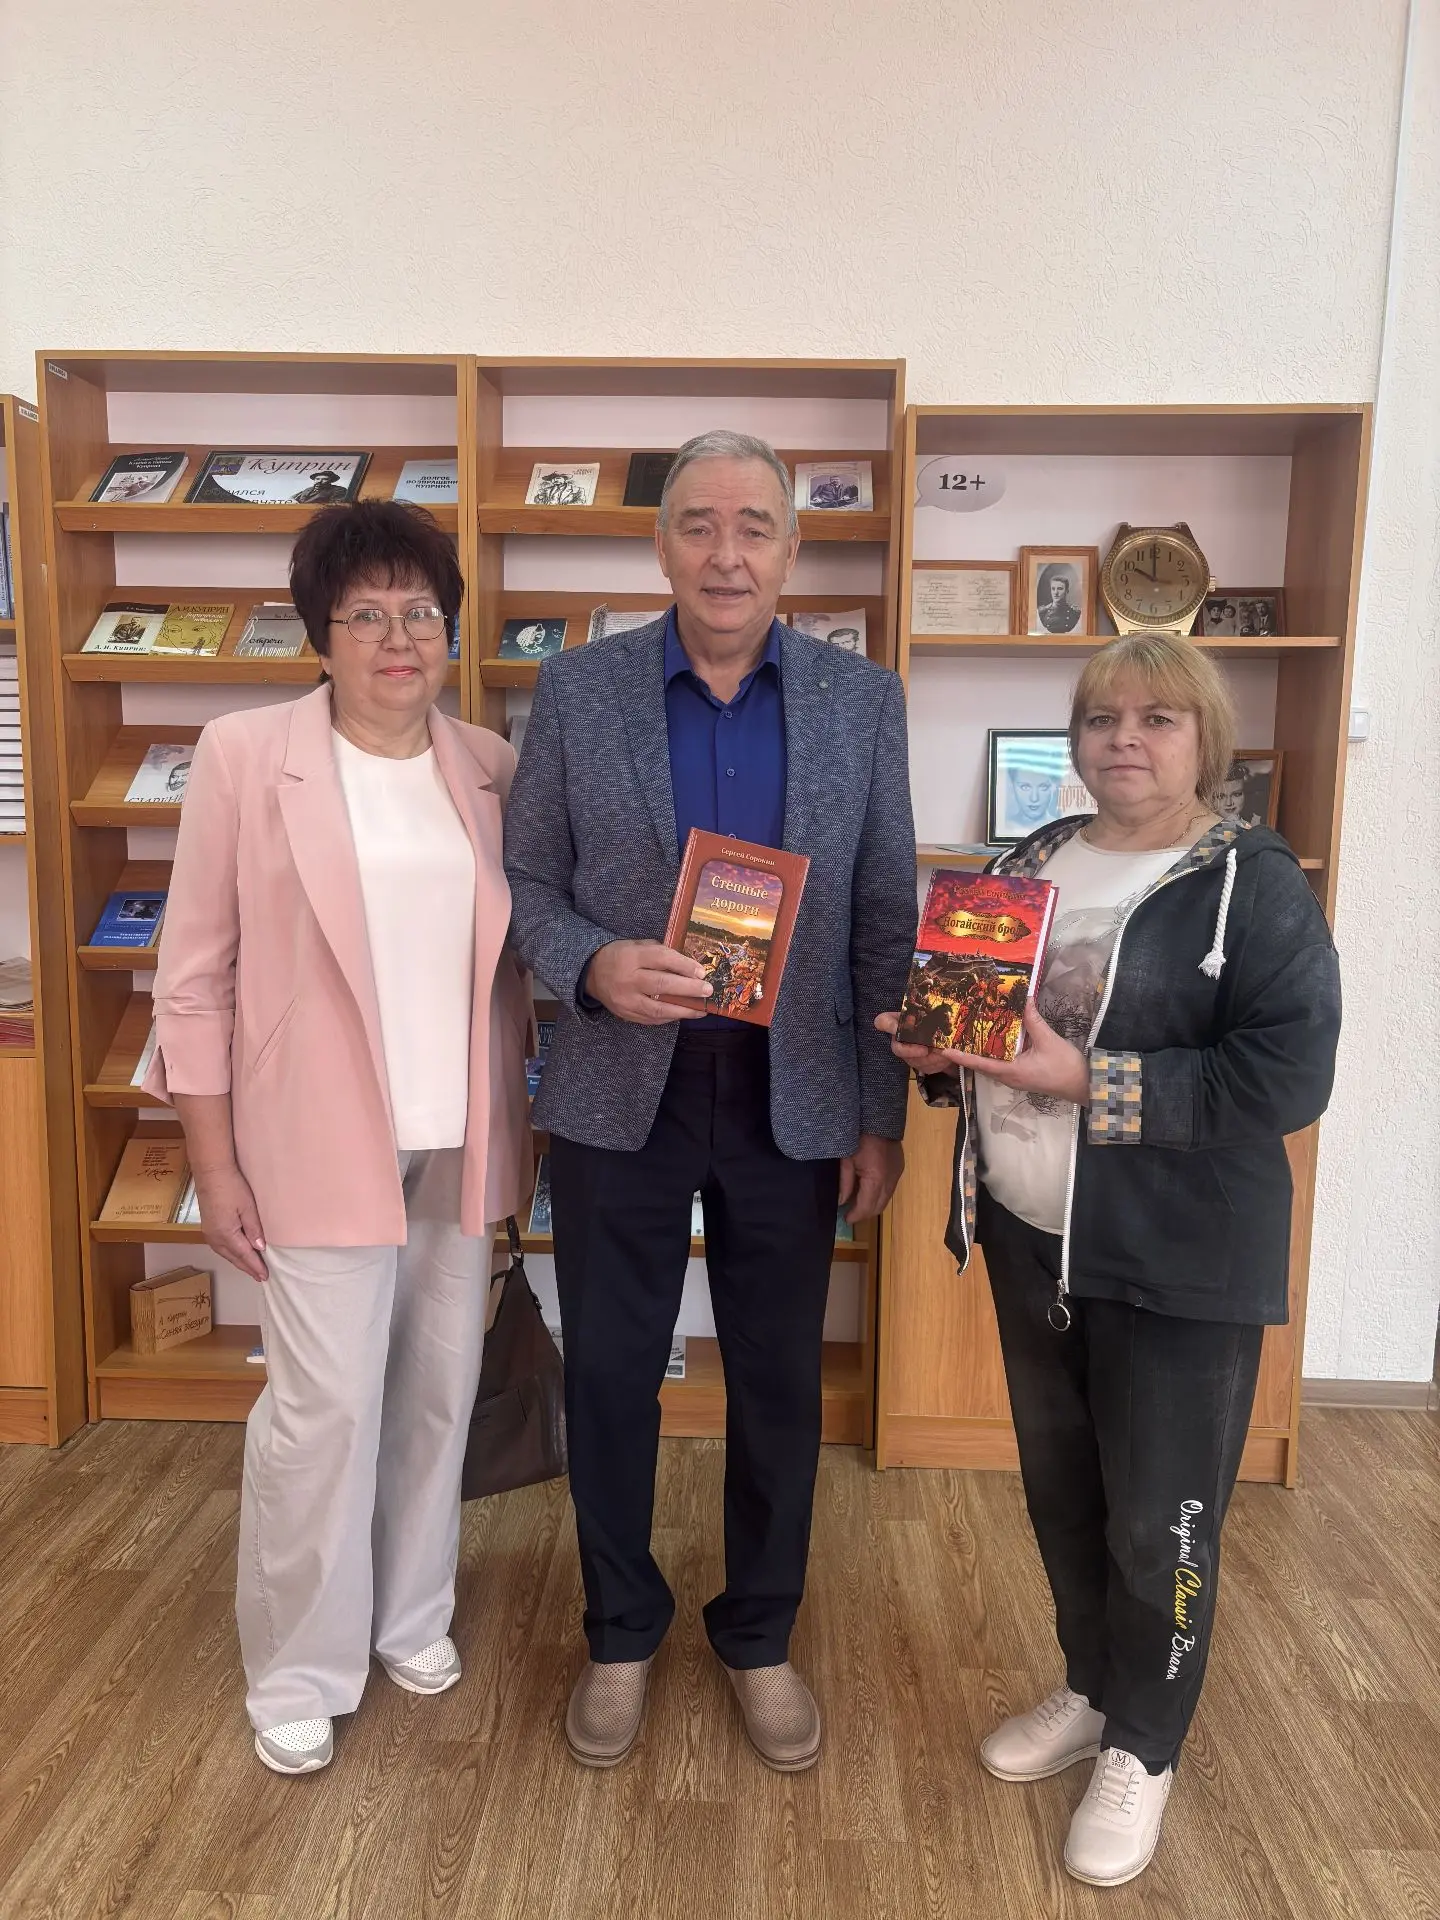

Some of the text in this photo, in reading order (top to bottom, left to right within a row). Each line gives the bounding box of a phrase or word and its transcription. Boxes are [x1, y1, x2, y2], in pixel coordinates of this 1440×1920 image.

[248, 458, 352, 475] Куприн
[938, 473, 986, 491] 12+
[1124, 560, 1136, 572] 10
[1176, 560, 1185, 572] 2
[1120, 573, 1129, 586] 9
[1124, 588, 1133, 600] 8
[721, 847, 745, 859] Сергей
[711, 875, 768, 900] Степные
[710, 896, 760, 916] дороги
[943, 916, 996, 933] Ногайский
[1169, 1499, 1204, 1569] Original
[1174, 1567, 1203, 1631] Classic
[1114, 1752, 1127, 1764] M
